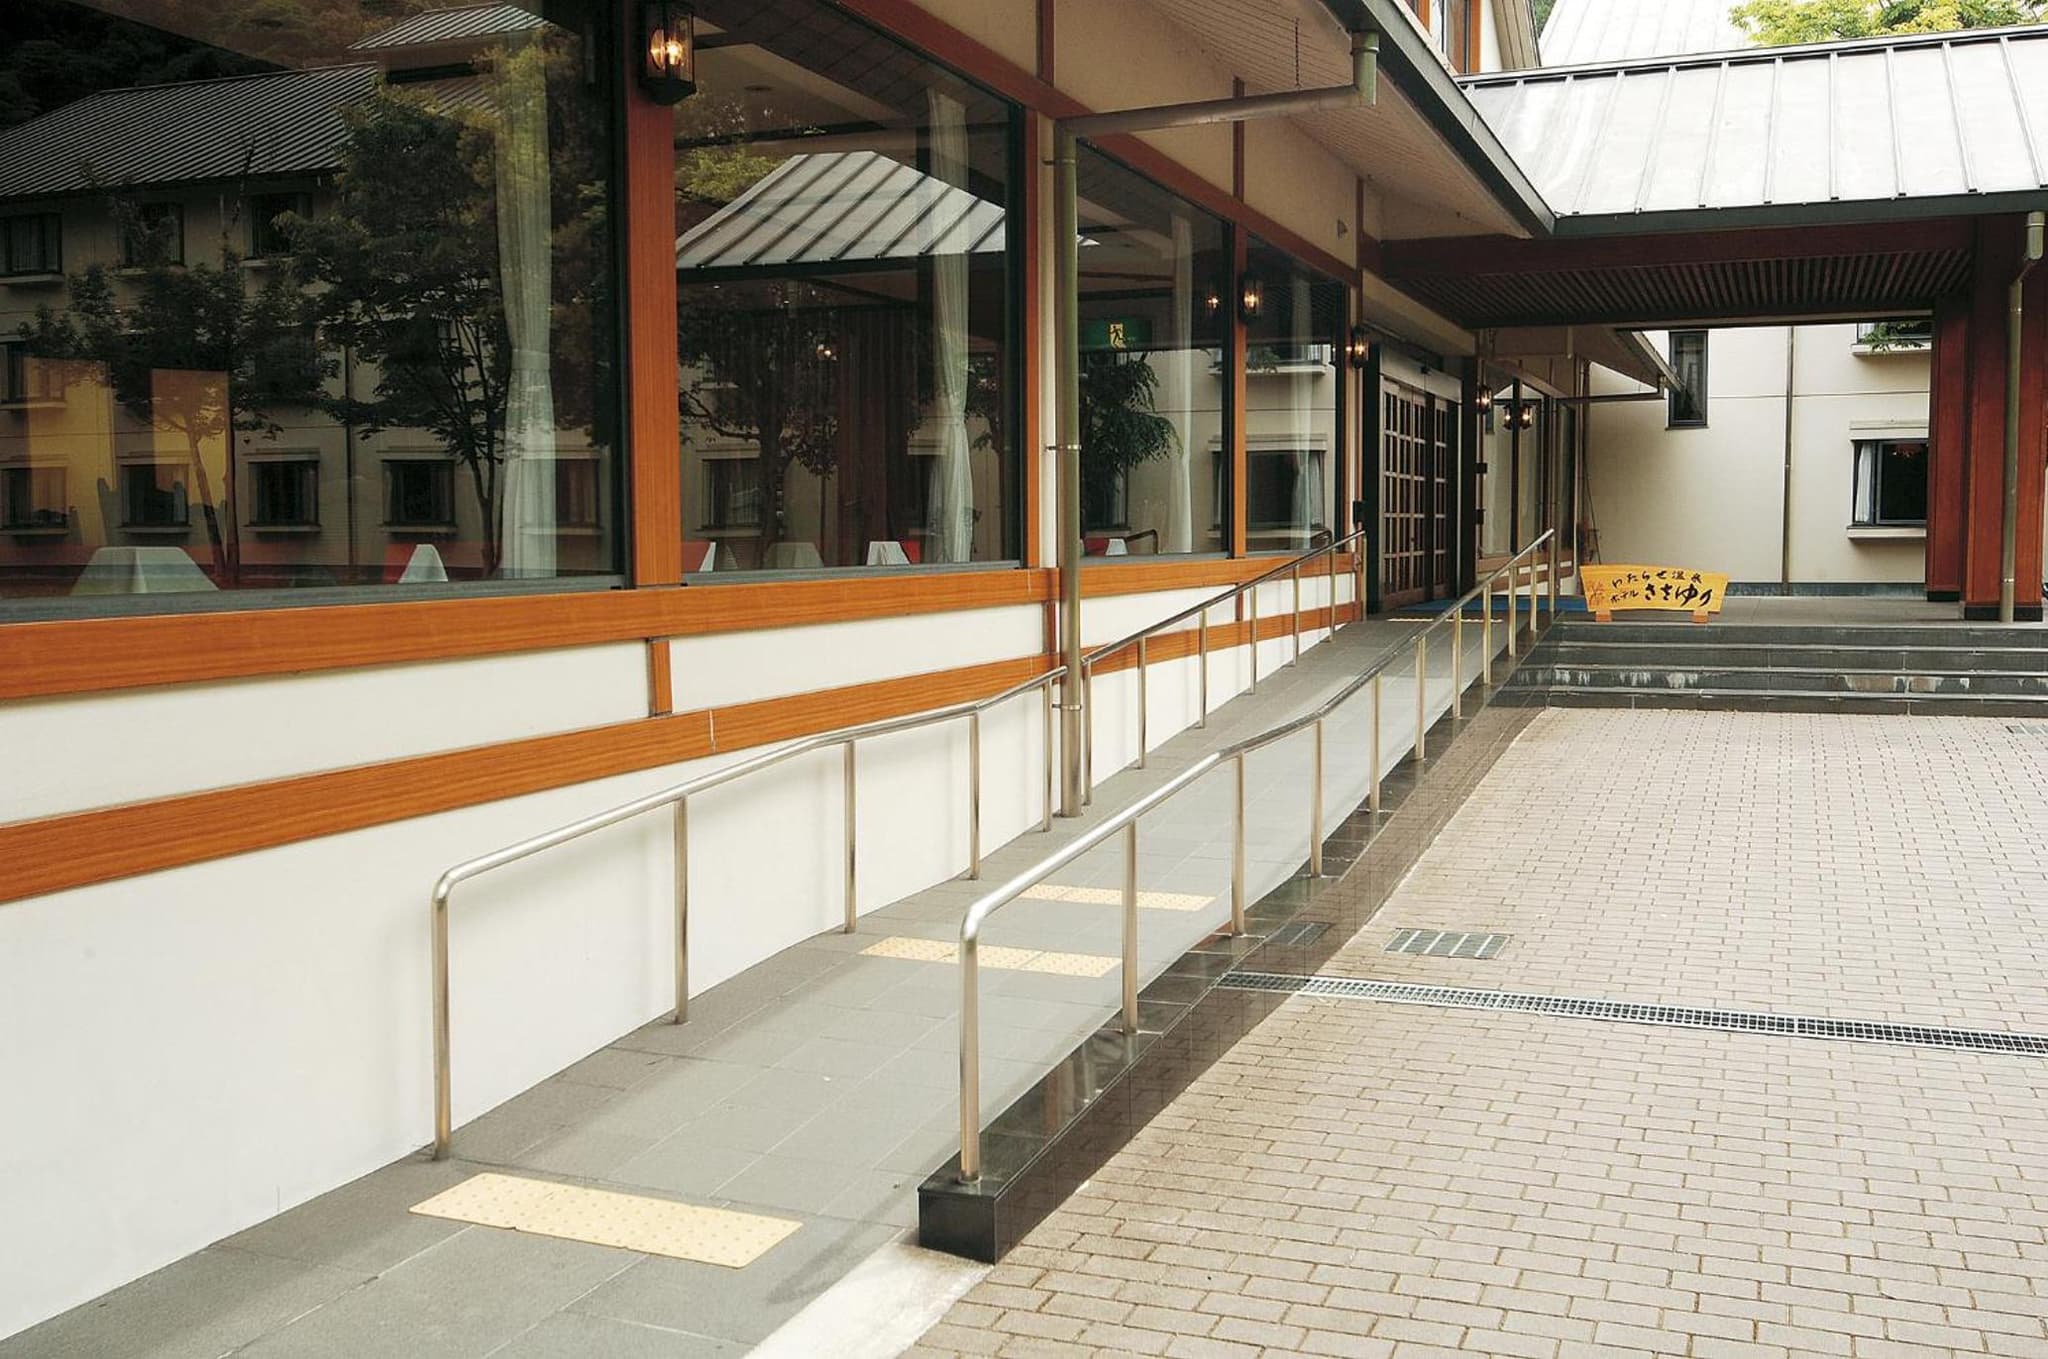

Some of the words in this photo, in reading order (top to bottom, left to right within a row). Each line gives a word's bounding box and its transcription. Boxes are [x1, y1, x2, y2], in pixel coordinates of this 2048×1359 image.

[1610, 589, 1639, 603] ホテル
[1644, 583, 1713, 607] ささゆり
